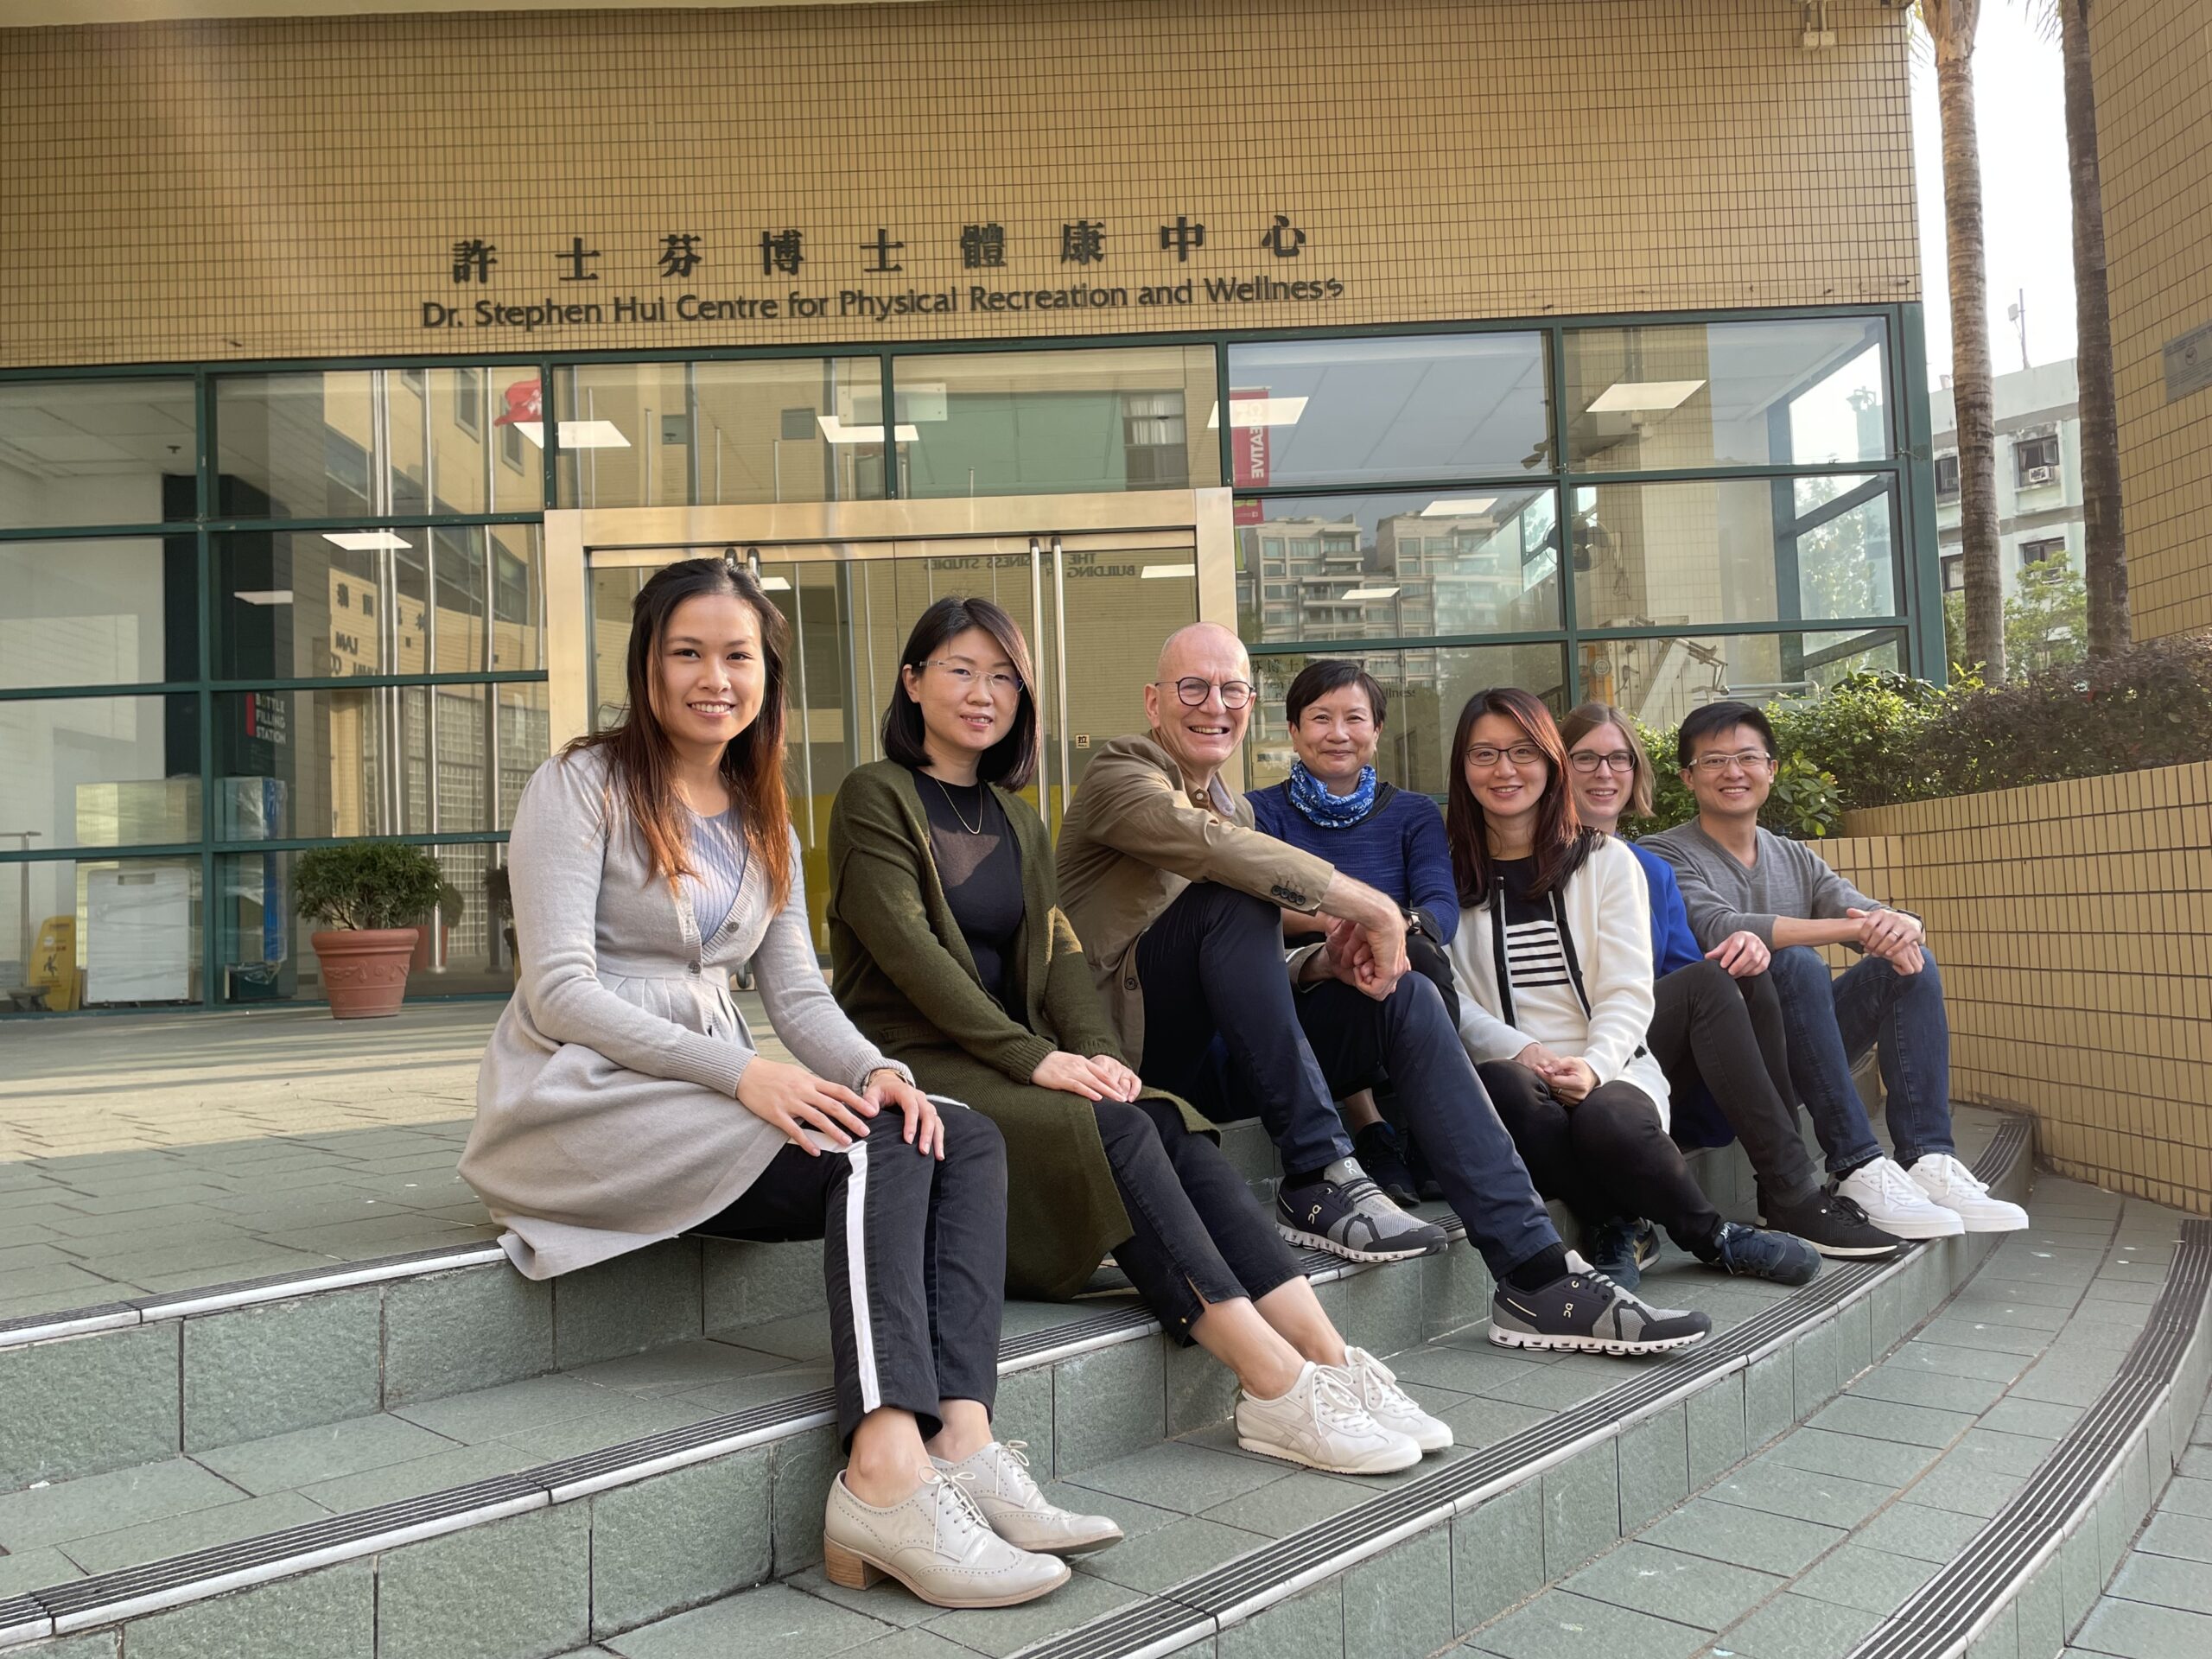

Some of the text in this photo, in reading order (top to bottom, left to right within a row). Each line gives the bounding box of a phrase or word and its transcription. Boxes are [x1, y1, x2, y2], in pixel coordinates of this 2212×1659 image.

[453, 214, 1306, 284] 許士芬博士體康中心
[423, 276, 1345, 333] Dr. Stephen Hui Centre for Physical Recreation and Wellness
[256, 693, 285, 714] BOTTLE
[256, 709, 286, 729] FILLING
[256, 725, 287, 744] STATION
